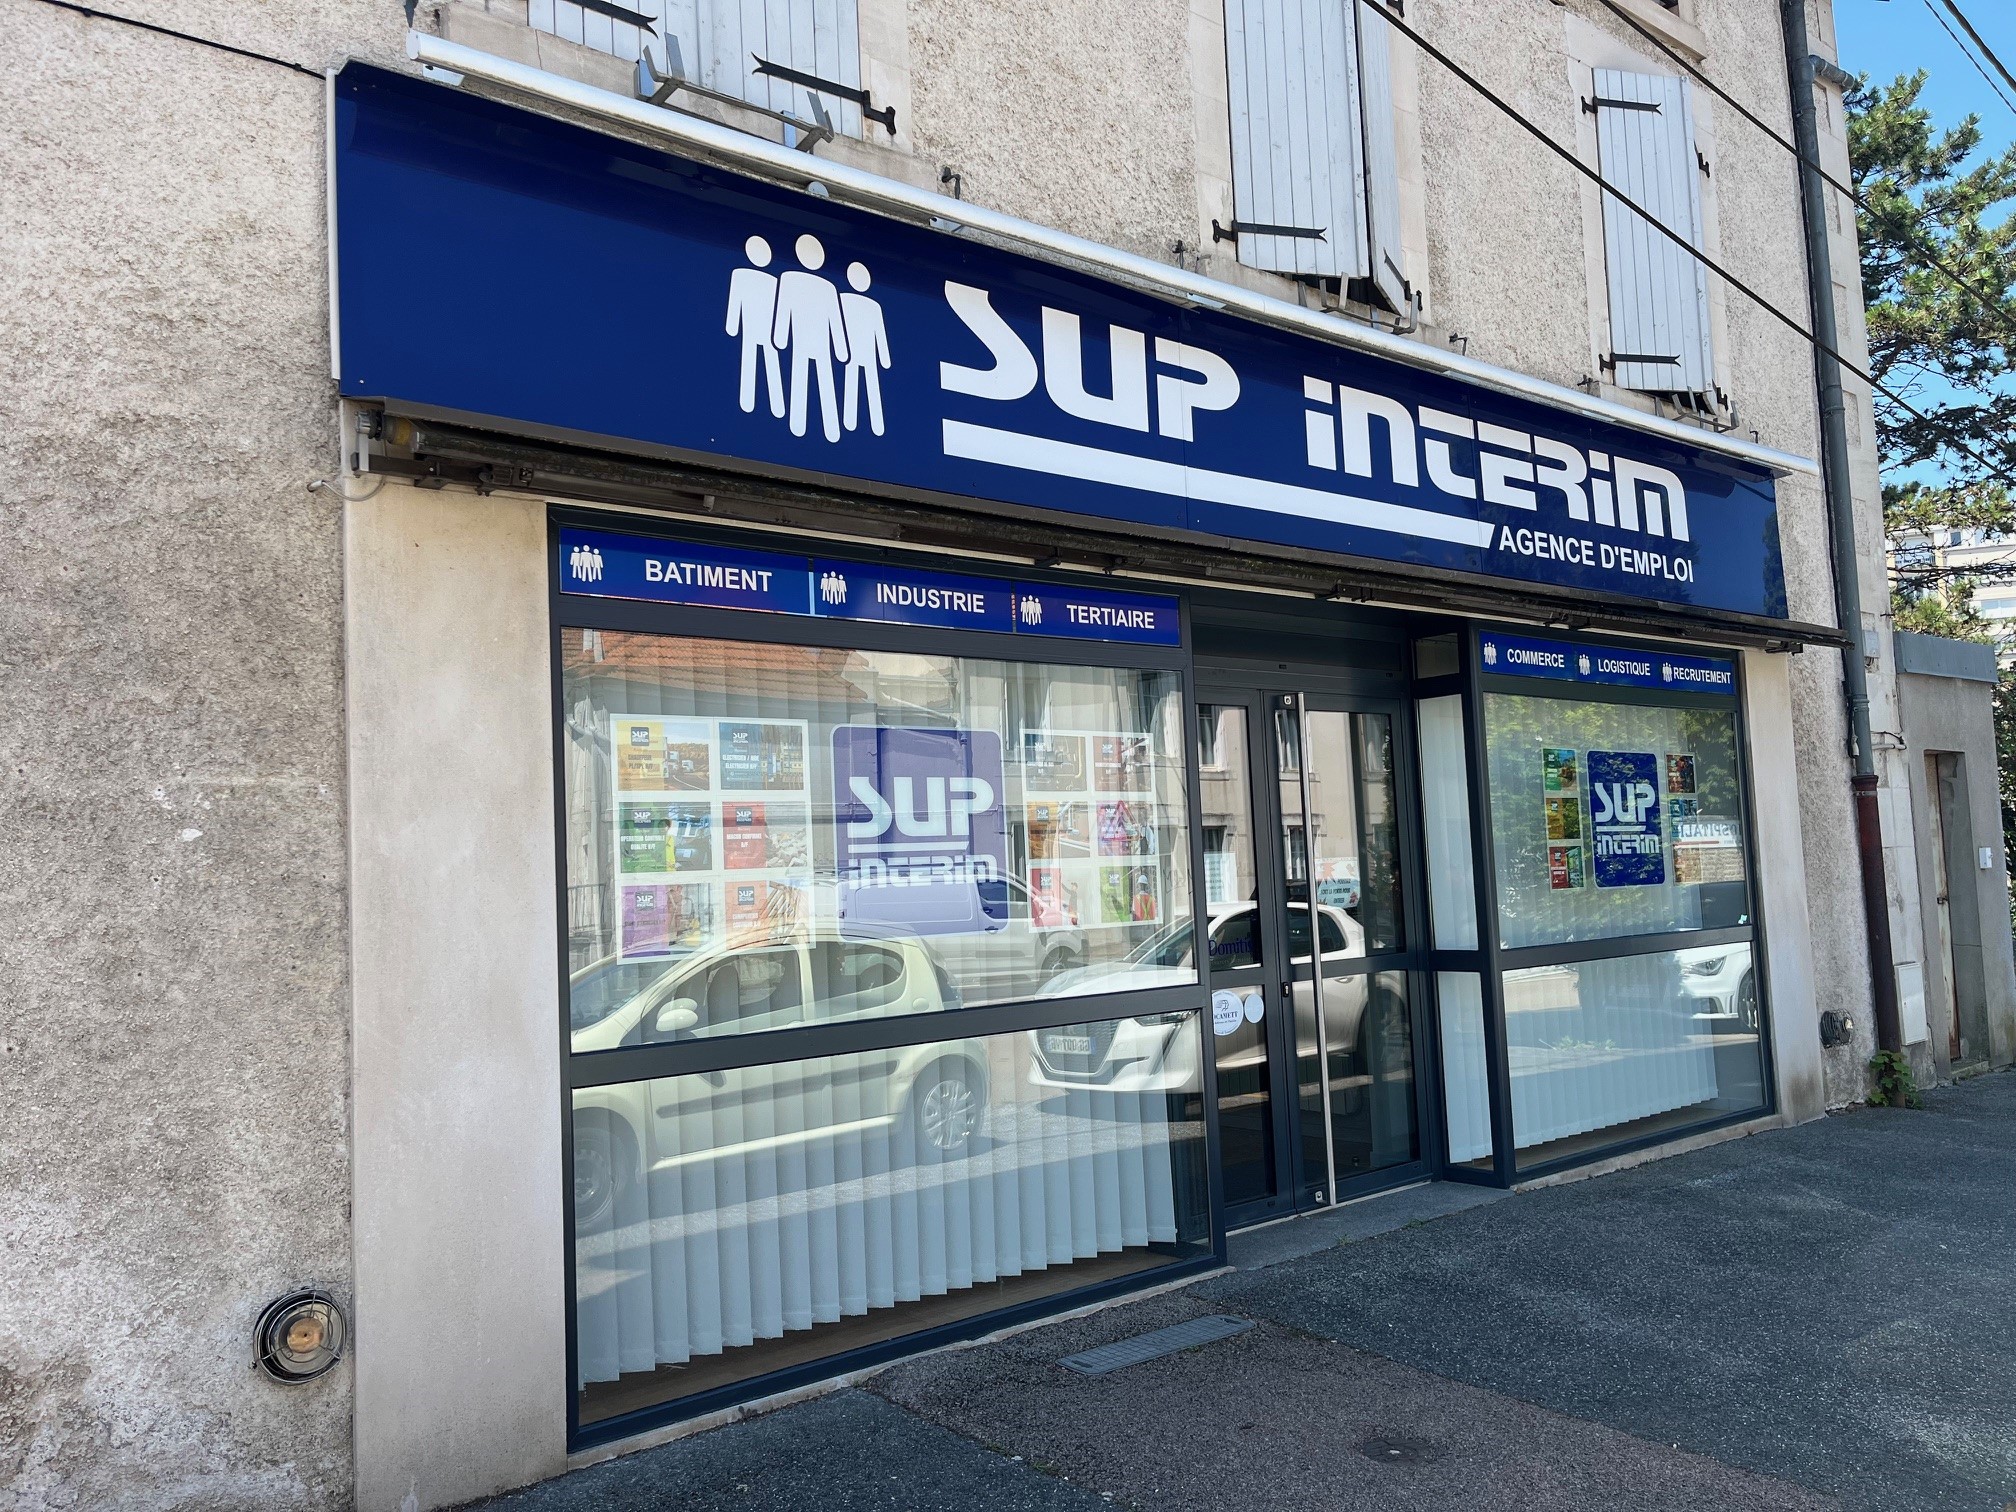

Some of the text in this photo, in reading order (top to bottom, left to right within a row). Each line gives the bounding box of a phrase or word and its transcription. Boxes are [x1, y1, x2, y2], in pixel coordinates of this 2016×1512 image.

[940, 280, 1240, 442] SUP
[1499, 525, 1693, 583] AGENCE D'EMPLOI
[645, 559, 772, 592] BATIMENT
[877, 583, 985, 614] INDUSTRIE
[1067, 604, 1154, 630] TERTIAIRE
[1507, 649, 1564, 668] COMMERCE
[1598, 658, 1650, 676] LOGISTIQUE
[1673, 667, 1731, 684] RECRUTEMENT
[847, 777, 994, 838] SUP
[1594, 783, 1656, 822] SUP
